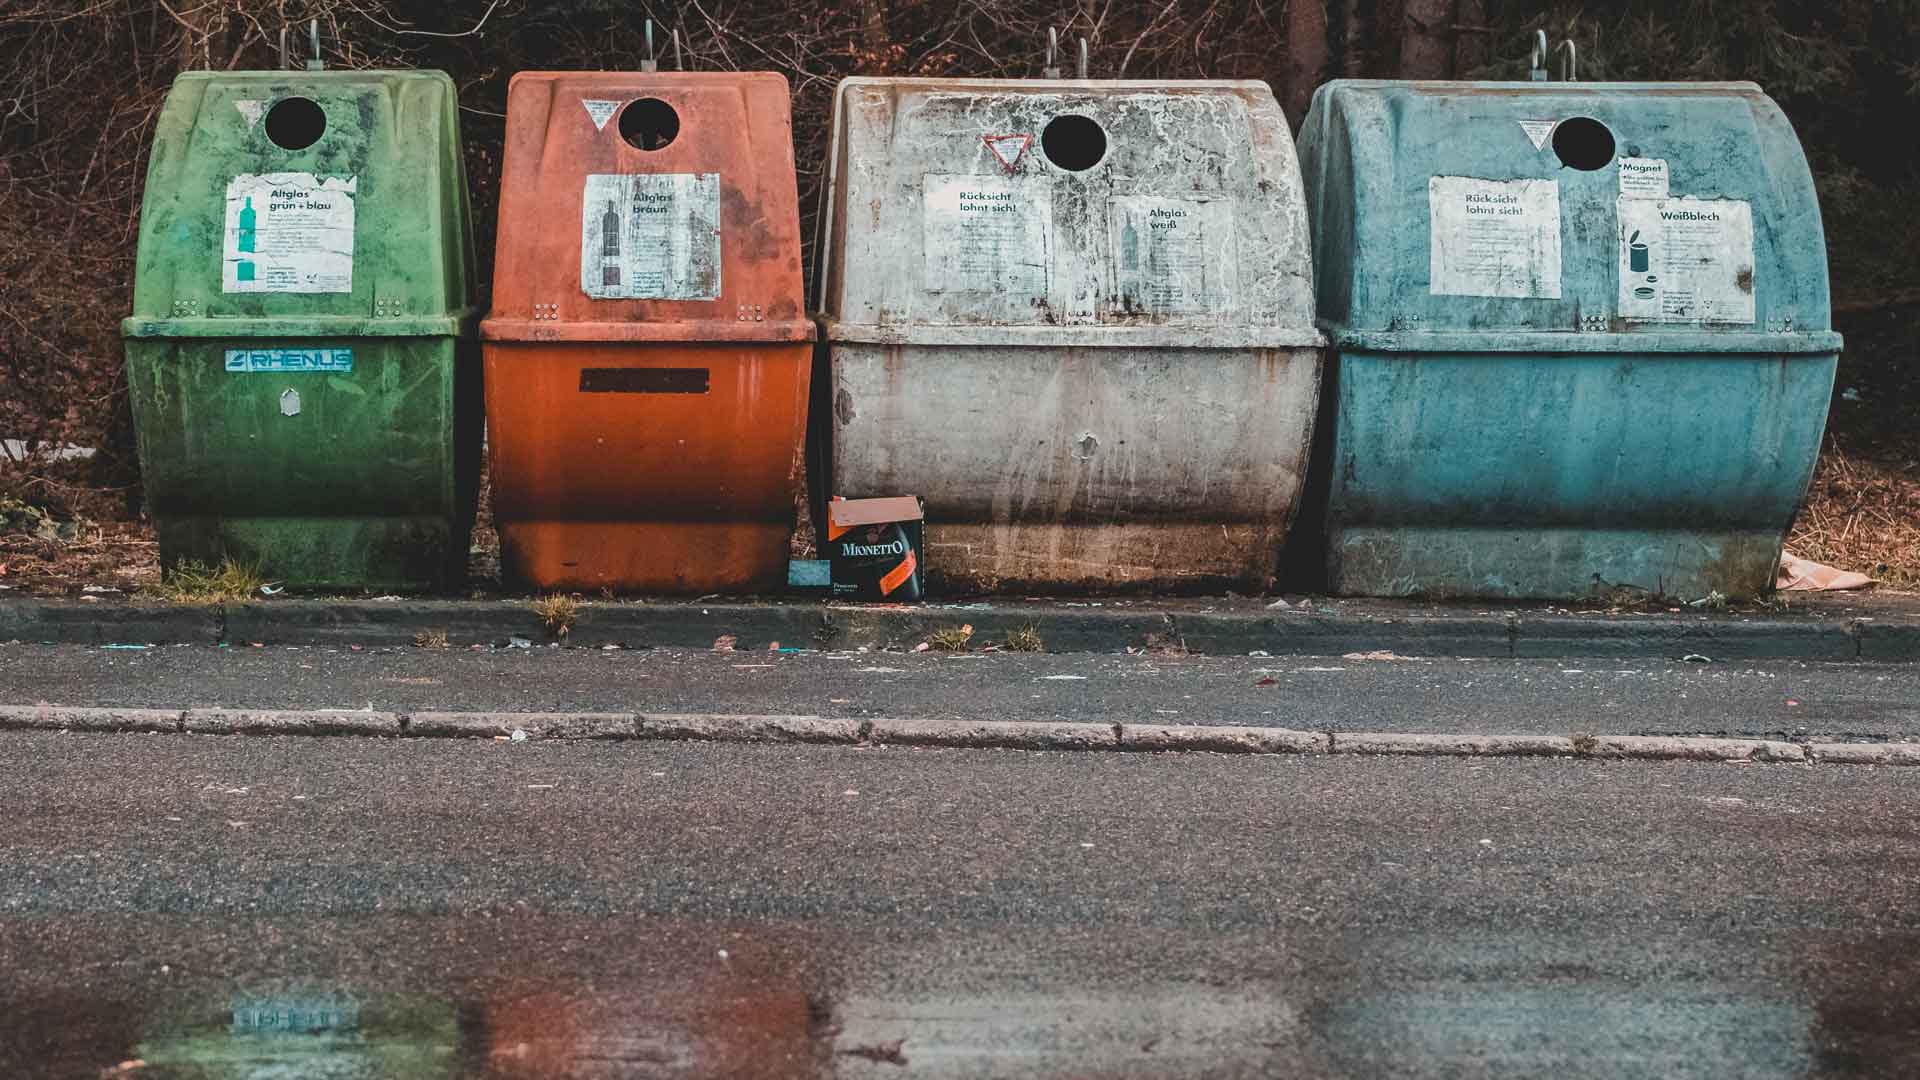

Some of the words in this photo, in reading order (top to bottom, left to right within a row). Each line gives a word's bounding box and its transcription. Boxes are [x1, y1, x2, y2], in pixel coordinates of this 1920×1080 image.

[270, 189, 309, 200] Altglas
[633, 193, 673, 204] Altglas
[959, 192, 1012, 201] Rücksicht
[1465, 194, 1518, 204] Rücksicht
[269, 202, 296, 211] grün
[306, 201, 332, 210] blau
[633, 204, 668, 214] braun
[959, 203, 988, 212] lohnt
[992, 203, 1017, 212] sich!
[1466, 205, 1495, 215] lohnt
[1499, 206, 1523, 216] sich!
[1149, 208, 1188, 219] Altglas
[1661, 211, 1720, 221] Weißblech
[1150, 220, 1177, 230] weiß
[251, 353, 352, 366] RHENUS
